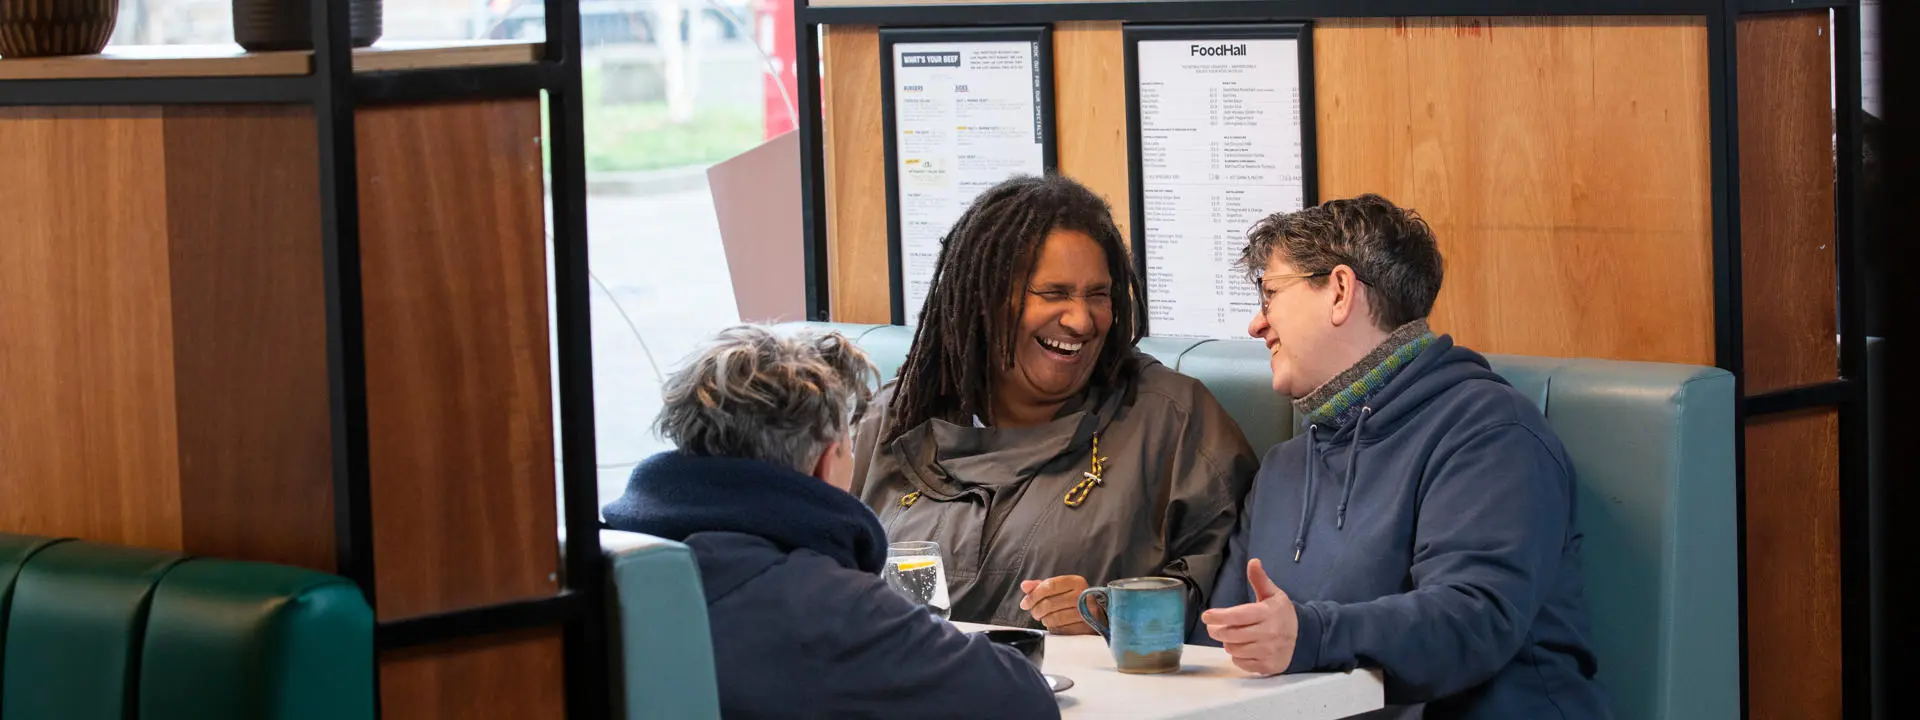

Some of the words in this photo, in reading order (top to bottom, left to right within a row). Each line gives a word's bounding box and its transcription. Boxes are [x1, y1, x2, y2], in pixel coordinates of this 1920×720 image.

[1191, 44, 1246, 57] FoodHall
[904, 55, 926, 64] WHAT'S
[927, 55, 942, 64] YOUR
[943, 55, 959, 63] BEEF
